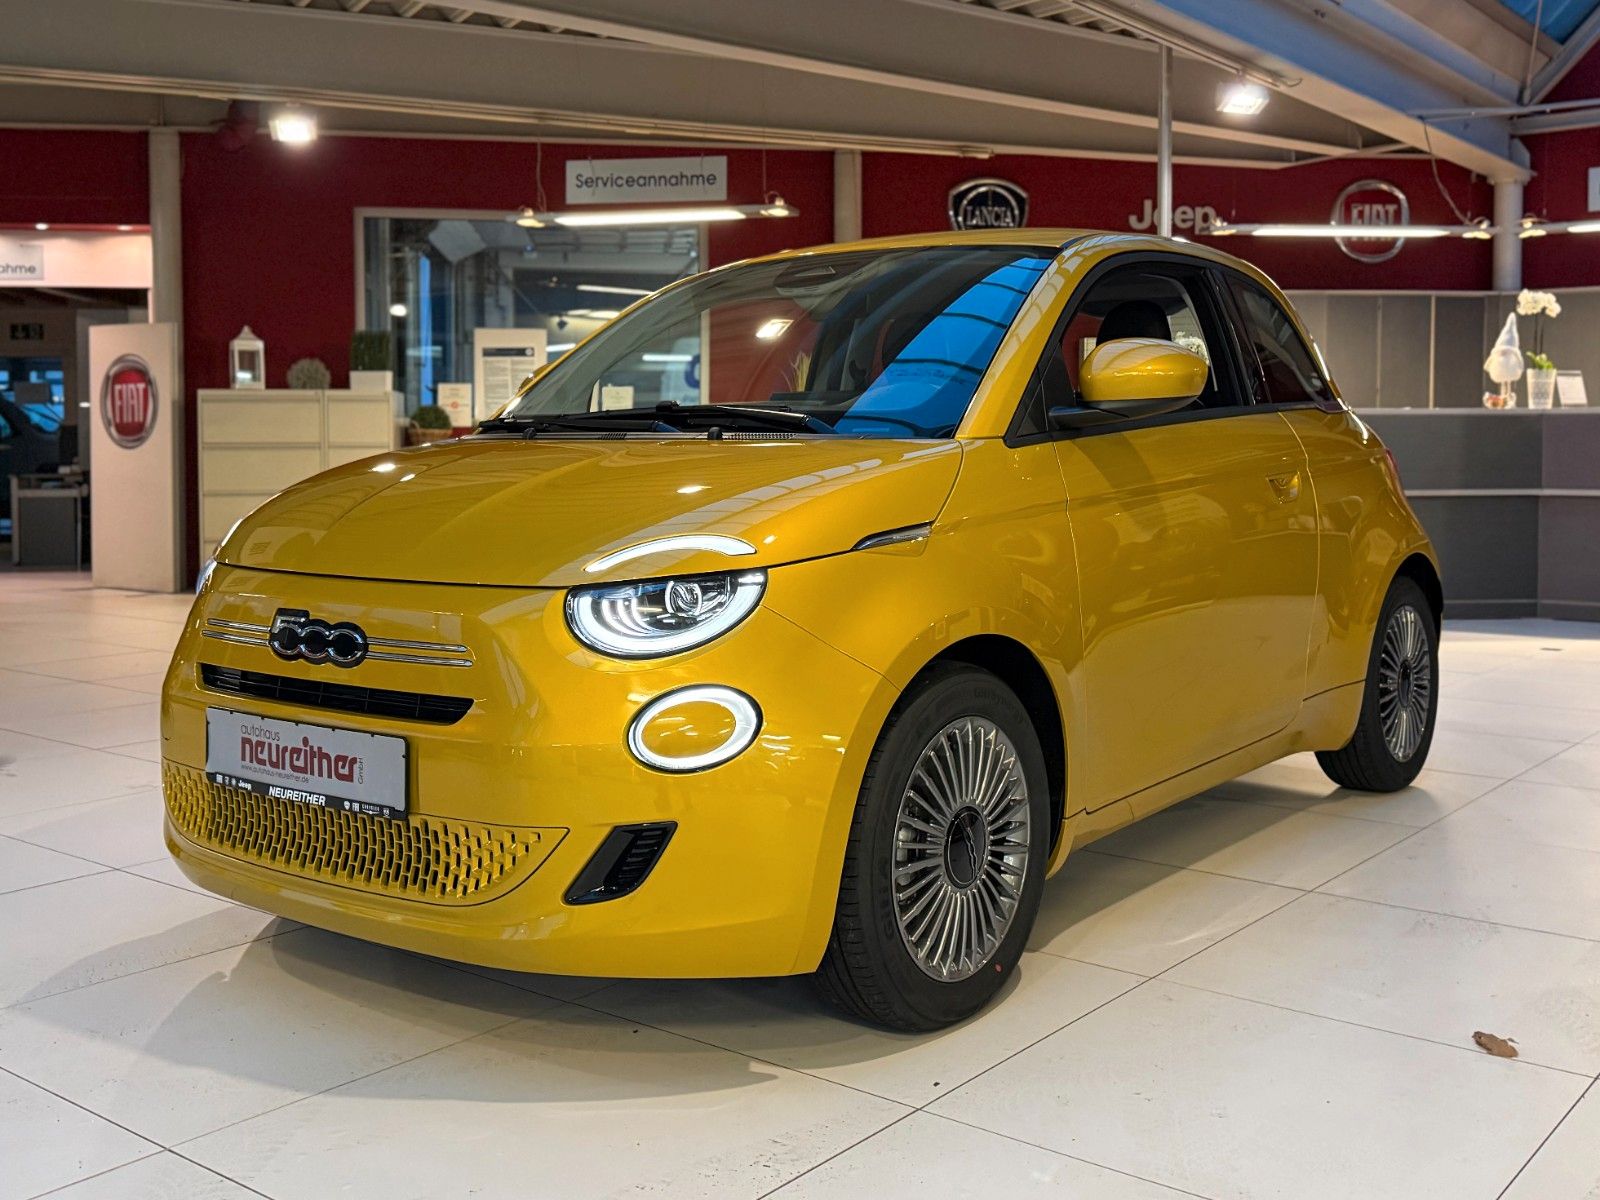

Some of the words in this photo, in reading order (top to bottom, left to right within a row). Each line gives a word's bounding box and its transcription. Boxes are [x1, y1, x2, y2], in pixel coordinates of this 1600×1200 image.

[575, 172, 717, 189] Serviceannahme
[966, 206, 1014, 227] LANCIA
[1128, 199, 1217, 235] Jep
[1351, 204, 1398, 241] FIAT
[114, 383, 146, 423] FIAT
[270, 608, 369, 668] 500
[240, 724, 280, 742] autohaus
[241, 736, 358, 784] neureither
[268, 785, 326, 807] NEUREITHER
